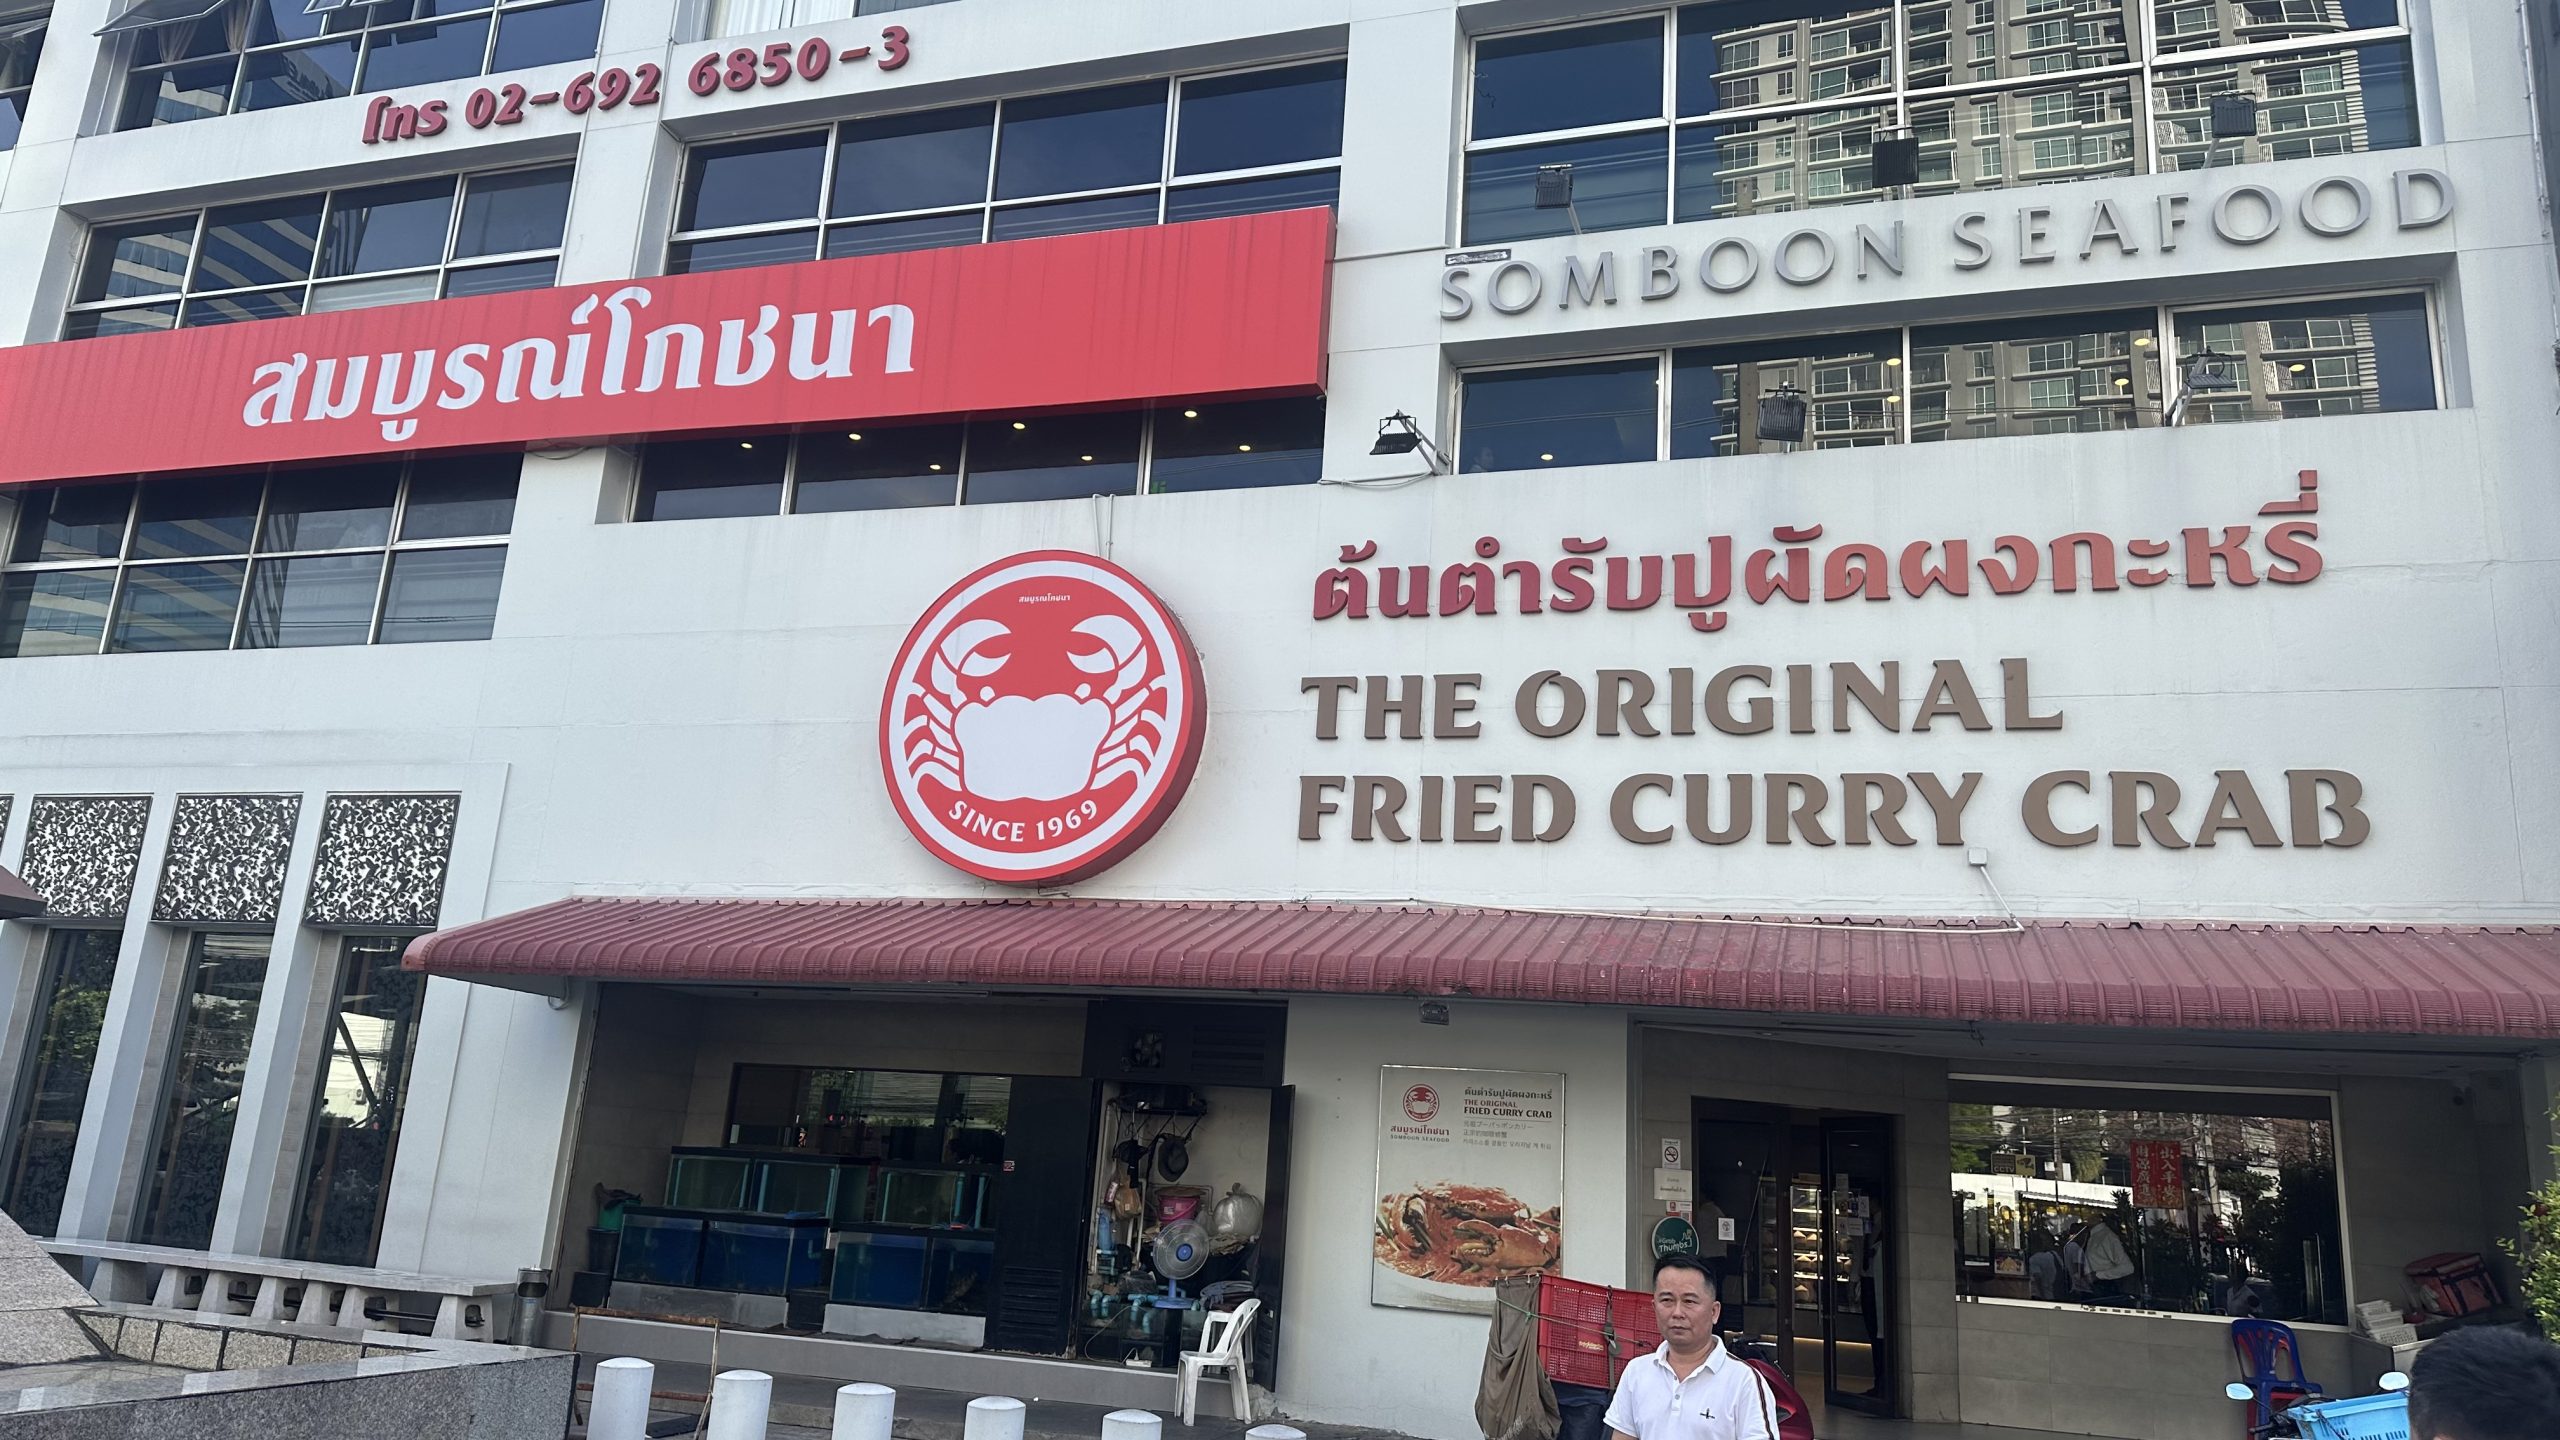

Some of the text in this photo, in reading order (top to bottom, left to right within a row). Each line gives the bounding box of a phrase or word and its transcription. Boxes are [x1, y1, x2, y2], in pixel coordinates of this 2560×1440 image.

[362, 25, 910, 144] โทร 02-692 6850-3
[1440, 167, 2456, 321] SOMBOON SEAFOOD
[242, 286, 915, 442] สมบูรณ์โภชนา
[1313, 469, 2324, 632] ต้นตำรับปูผัดผงกะหรี่
[1300, 657, 2064, 741] THE ORIGINAL
[948, 799, 1099, 843] SINCE 1969
[1298, 767, 2371, 849] FRIED CURRY CRAB
[1464, 1107, 1553, 1118] FRIED CURRY CRAB
[1480, 1100, 1518, 1108] ORIGINAL
[1659, 1241, 1688, 1253] Thumbs
